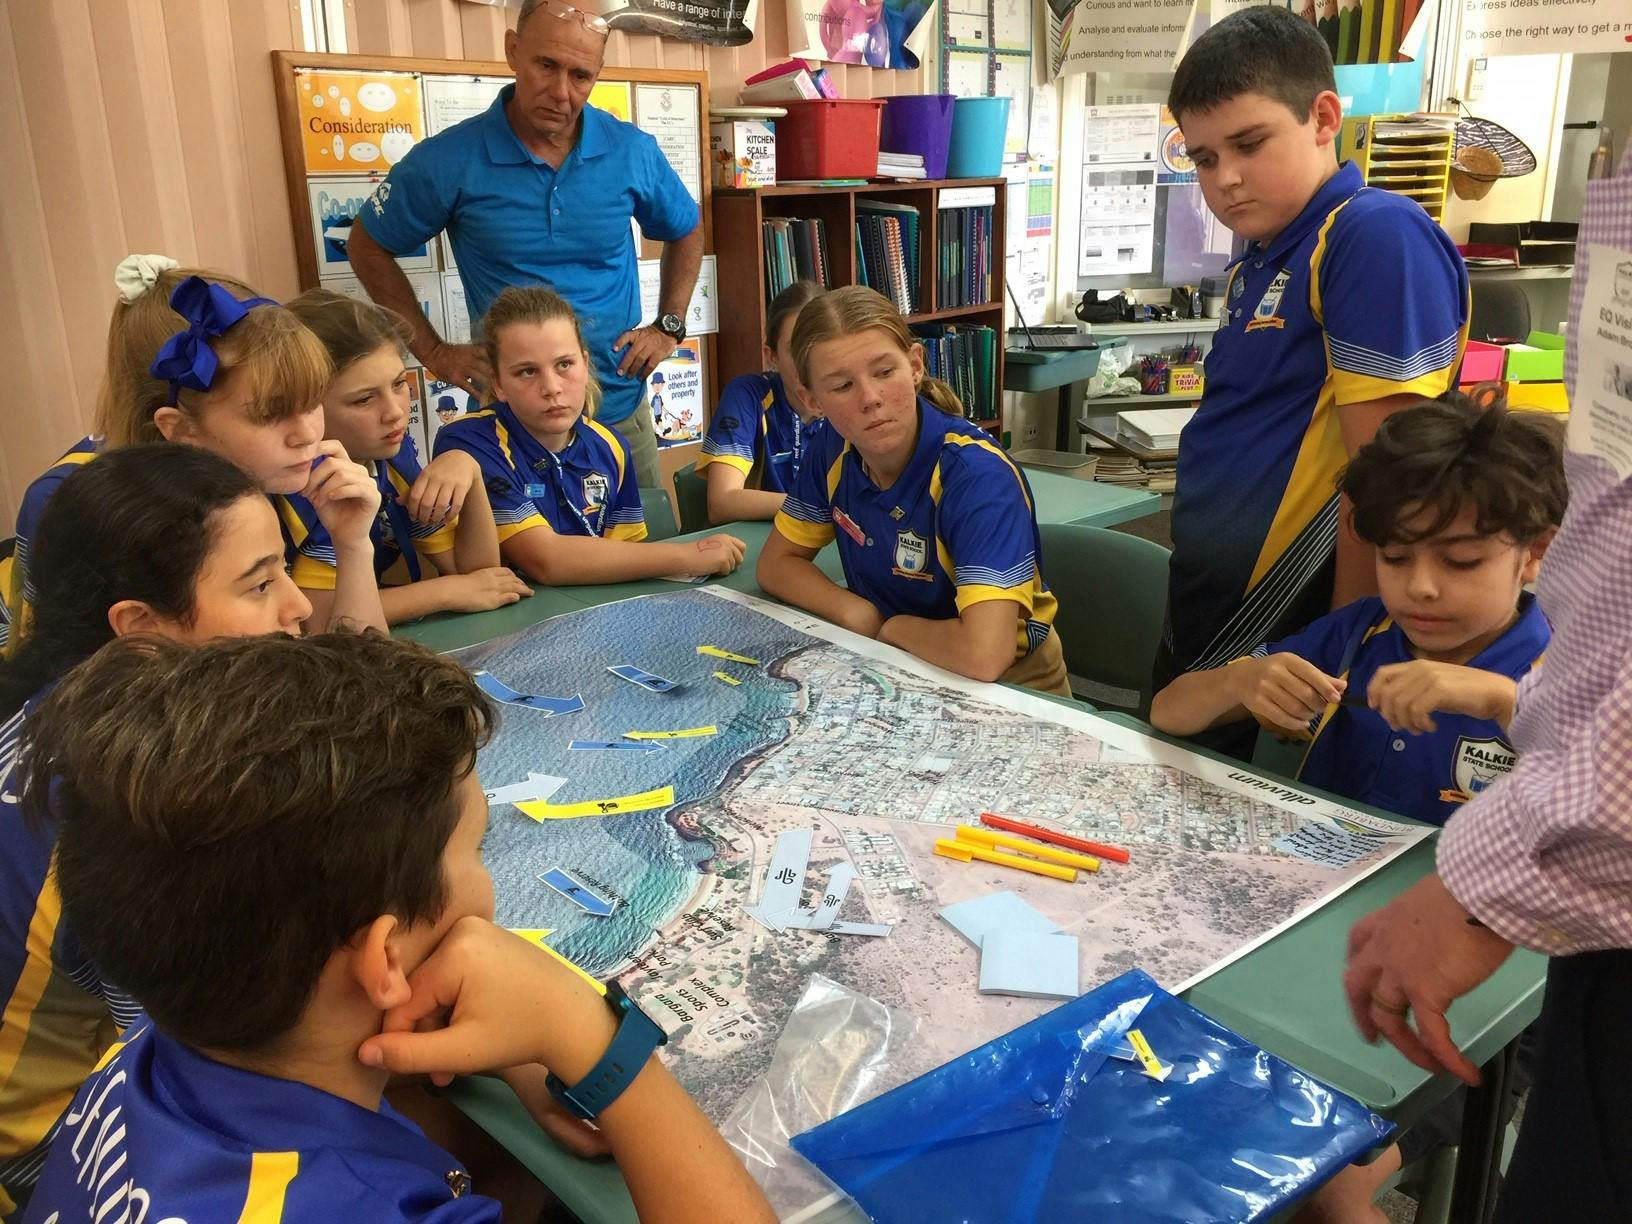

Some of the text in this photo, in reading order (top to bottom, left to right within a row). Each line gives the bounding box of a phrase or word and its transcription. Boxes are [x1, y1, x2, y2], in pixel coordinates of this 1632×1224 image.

[678, 2, 684, 12] a
[685, 5, 709, 18] range
[711, 8, 721, 18] of
[1086, 1, 1116, 10] Curious
[1117, 0, 1131, 9] and
[1133, 0, 1152, 8] want
[1153, 0, 1162, 8] to
[1466, 0, 1507, 11] Exress
[1510, 0, 1539, 8] ideas
[804, 12, 851, 26] contributions
[1078, 25, 1110, 35] Analyse
[1111, 25, 1126, 33] and
[1127, 24, 1160, 33] evaluate
[1505, 28, 1523, 37] the
[1525, 26, 1549, 39] right
[1552, 25, 1575, 37] way
[1577, 24, 1589, 34] to
[1591, 23, 1610, 35] get
[1613, 23, 1621, 31] a
[1070, 49, 1124, 60] understanding
[1125, 49, 1139, 58] from
[1140, 48, 1162, 58] what
[309, 117, 413, 134] Consideration
[746, 135, 775, 144] KITCHEN
[746, 146, 768, 155] SCALE
[668, 370, 697, 381] Look after
[668, 379, 699, 390] others and
[671, 389, 696, 400] property
[900, 536, 922, 548] KALKIE
[1463, 755, 1484, 768] STATE
[1465, 745, 1517, 767] KALKIE
[1227, 771, 1317, 806] alluvium
[1333, 808, 1416, 833] BUNDABERG
[682, 913, 722, 941] Surf Club
[649, 949, 672, 967] Park
[688, 977, 730, 1008] Complex
[675, 988, 709, 1012] Sports
[654, 993, 694, 1023] Bargara
